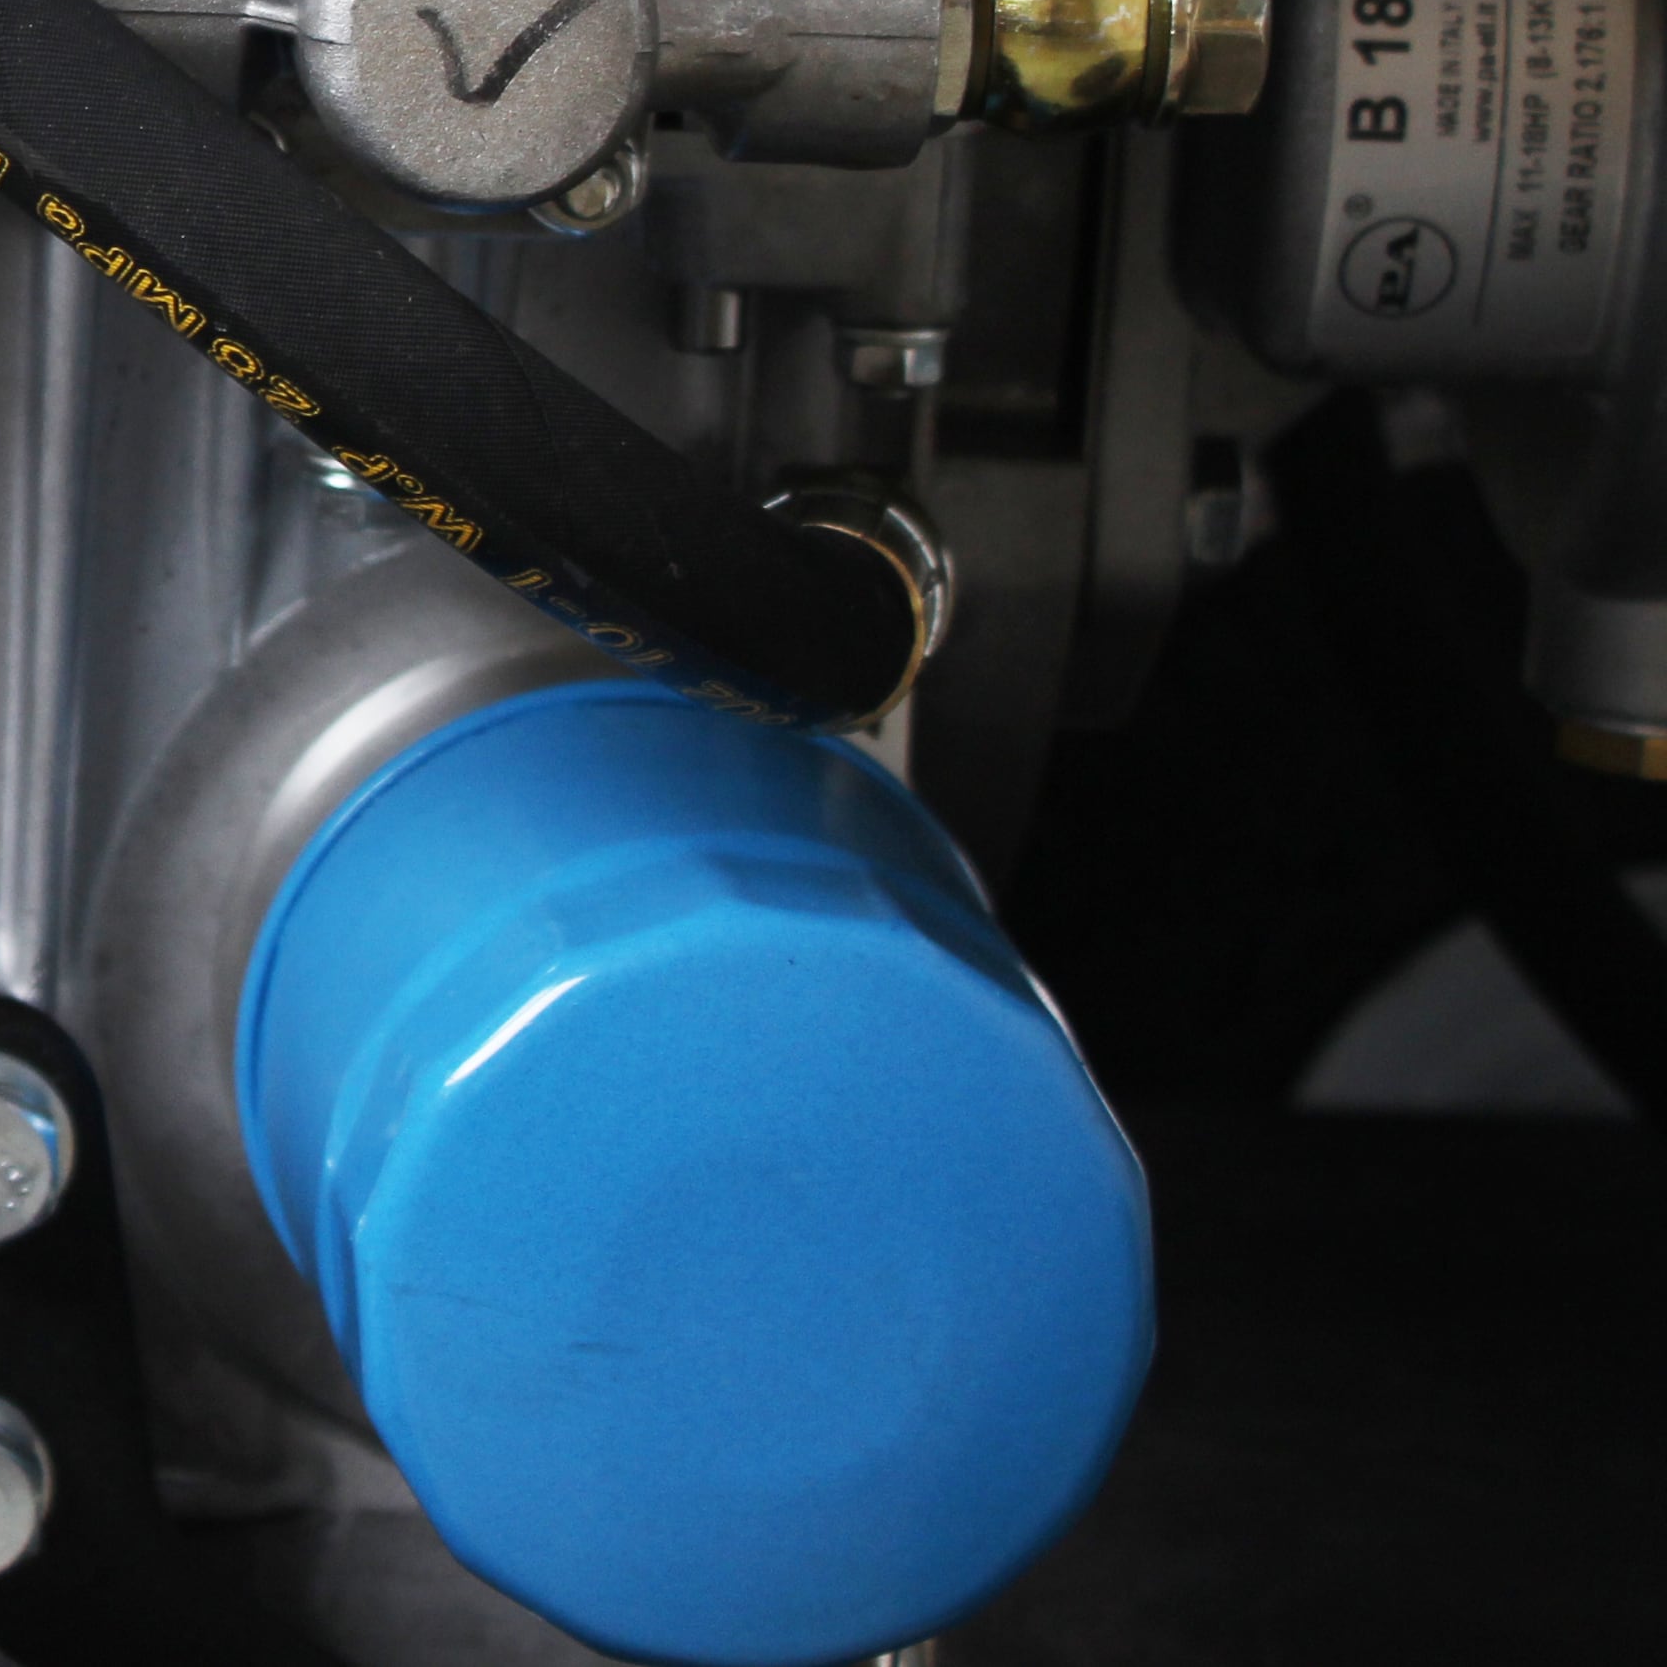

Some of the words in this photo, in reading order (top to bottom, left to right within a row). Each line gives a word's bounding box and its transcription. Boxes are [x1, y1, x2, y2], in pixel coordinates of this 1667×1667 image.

[1438, 2, 1465, 56] ITALY
[1438, 58, 1462, 78] IN
[1346, 94, 1409, 144] B
[1435, 82, 1463, 138] MADE
[1566, 100, 1603, 179] RATIO
[1506, 209, 1539, 262] MAX
[1558, 186, 1594, 253] GEAR
